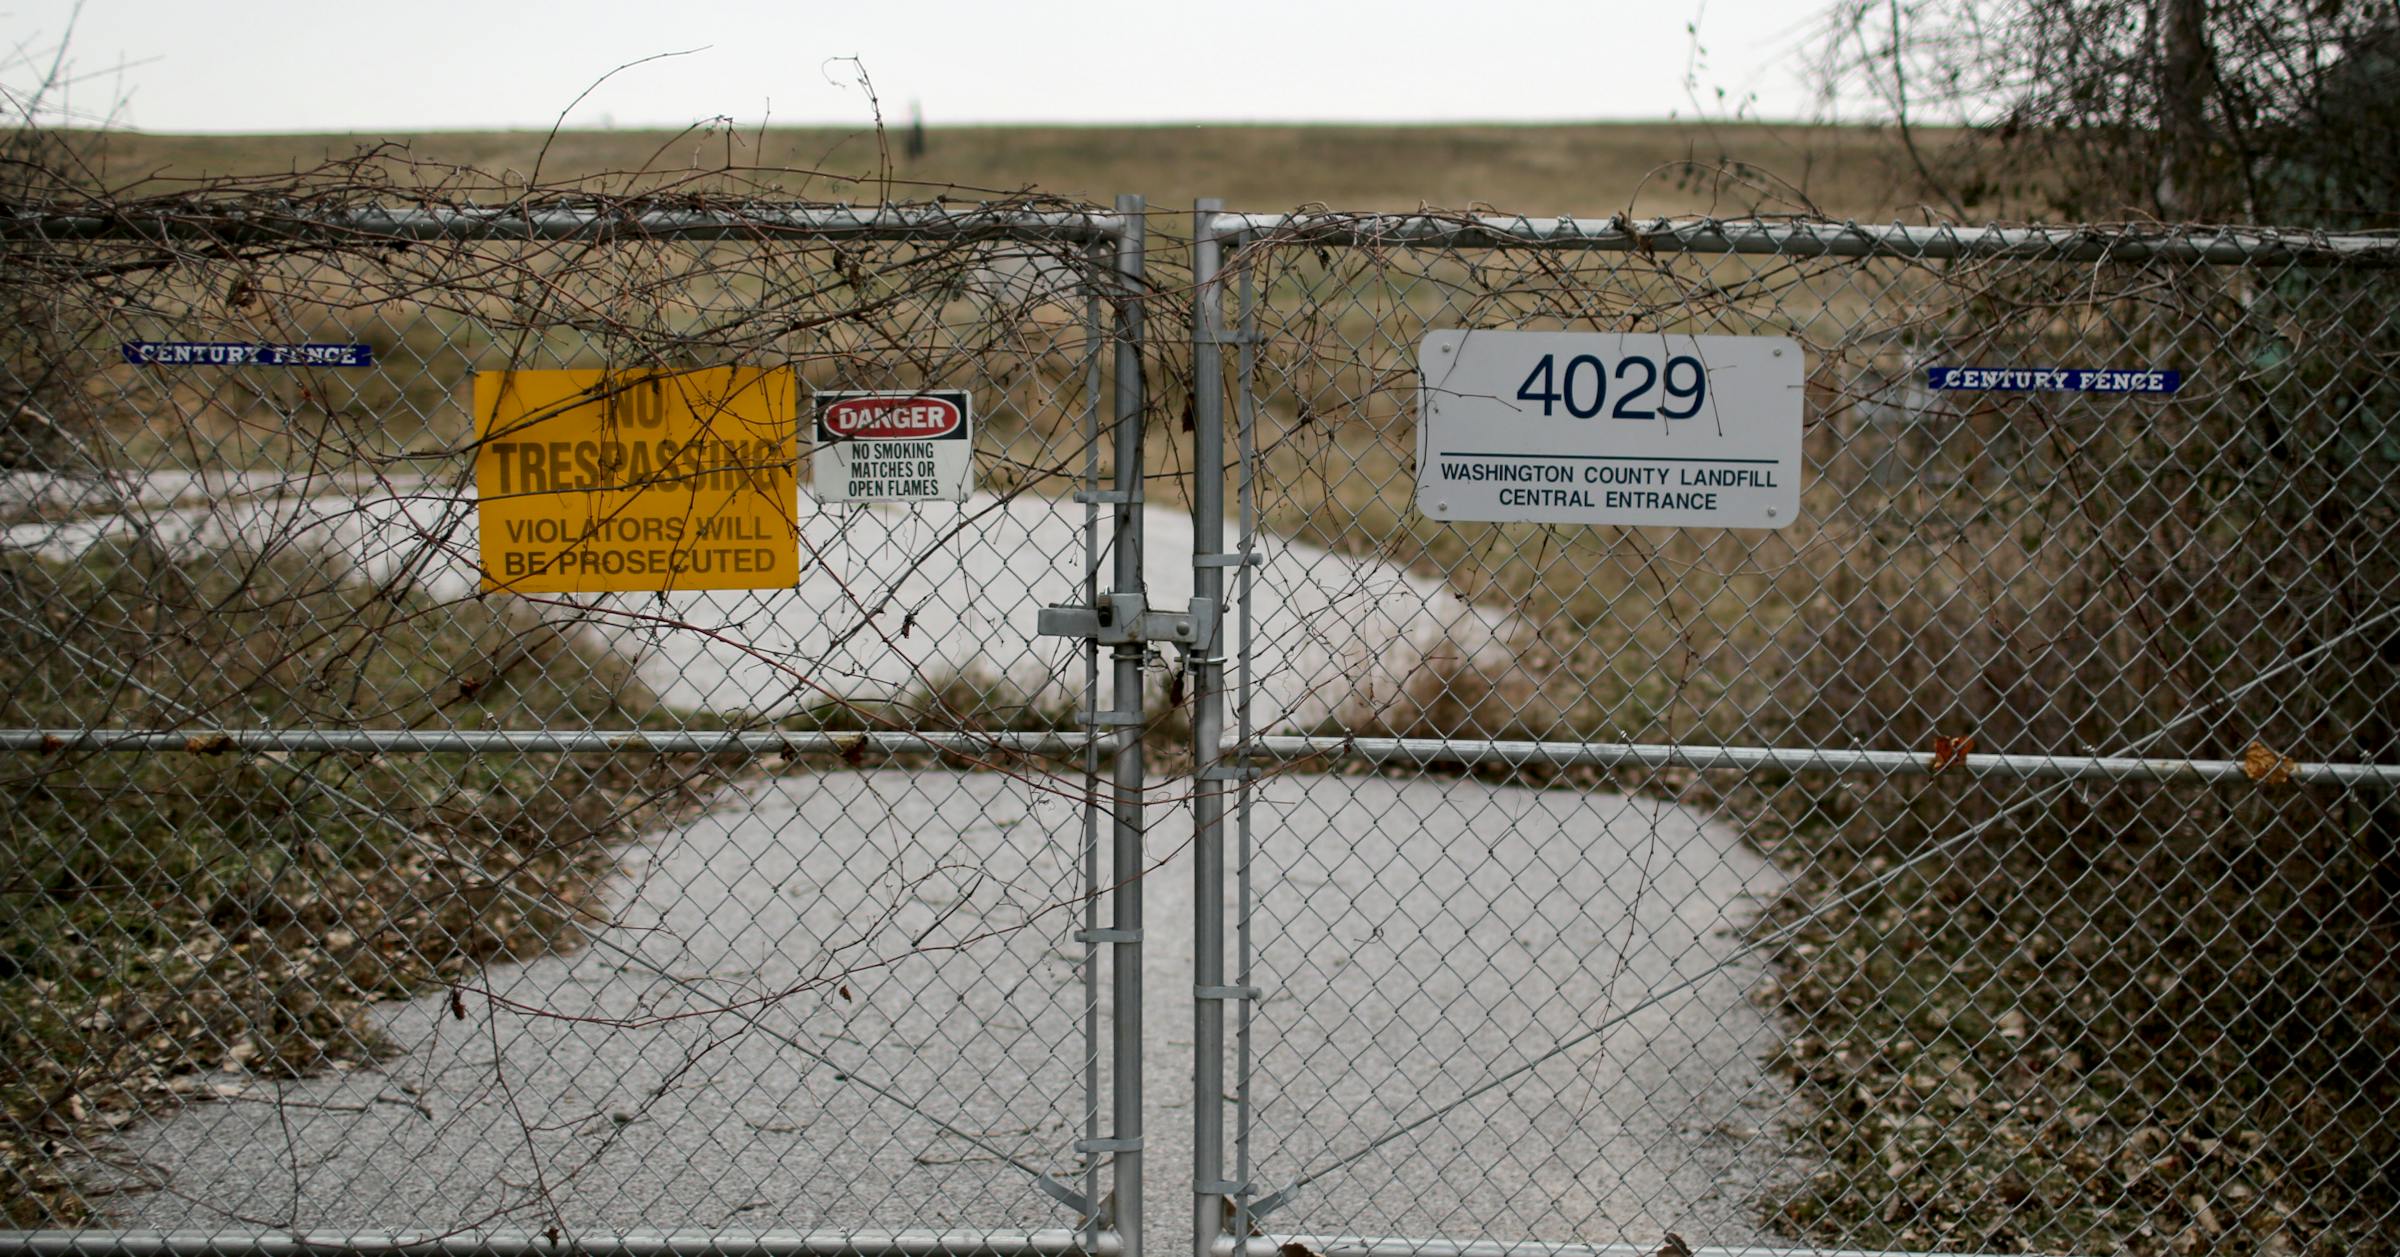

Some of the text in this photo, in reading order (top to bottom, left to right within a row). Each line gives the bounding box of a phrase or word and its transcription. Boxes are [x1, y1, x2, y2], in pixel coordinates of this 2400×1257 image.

[139, 344, 262, 363] CENTURY
[1516, 353, 1707, 420] 4029
[1945, 370, 2165, 391] CENTURY FENCE
[608, 376, 664, 429] NO
[839, 406, 945, 429] DANGER
[852, 442, 934, 460] NO SMOKING
[492, 438, 781, 494] TRESPASSING
[851, 461, 936, 478] MATCHES OR
[1441, 463, 1778, 488] WASHINGTON COUNTY LANDFILL
[848, 479, 939, 497] OPEN FLAMES
[1499, 488, 1718, 511] CENTRAL ENTRANCE
[505, 516, 773, 543] VIOLATORS WILL
[505, 548, 776, 576] BE PROSECUTED
